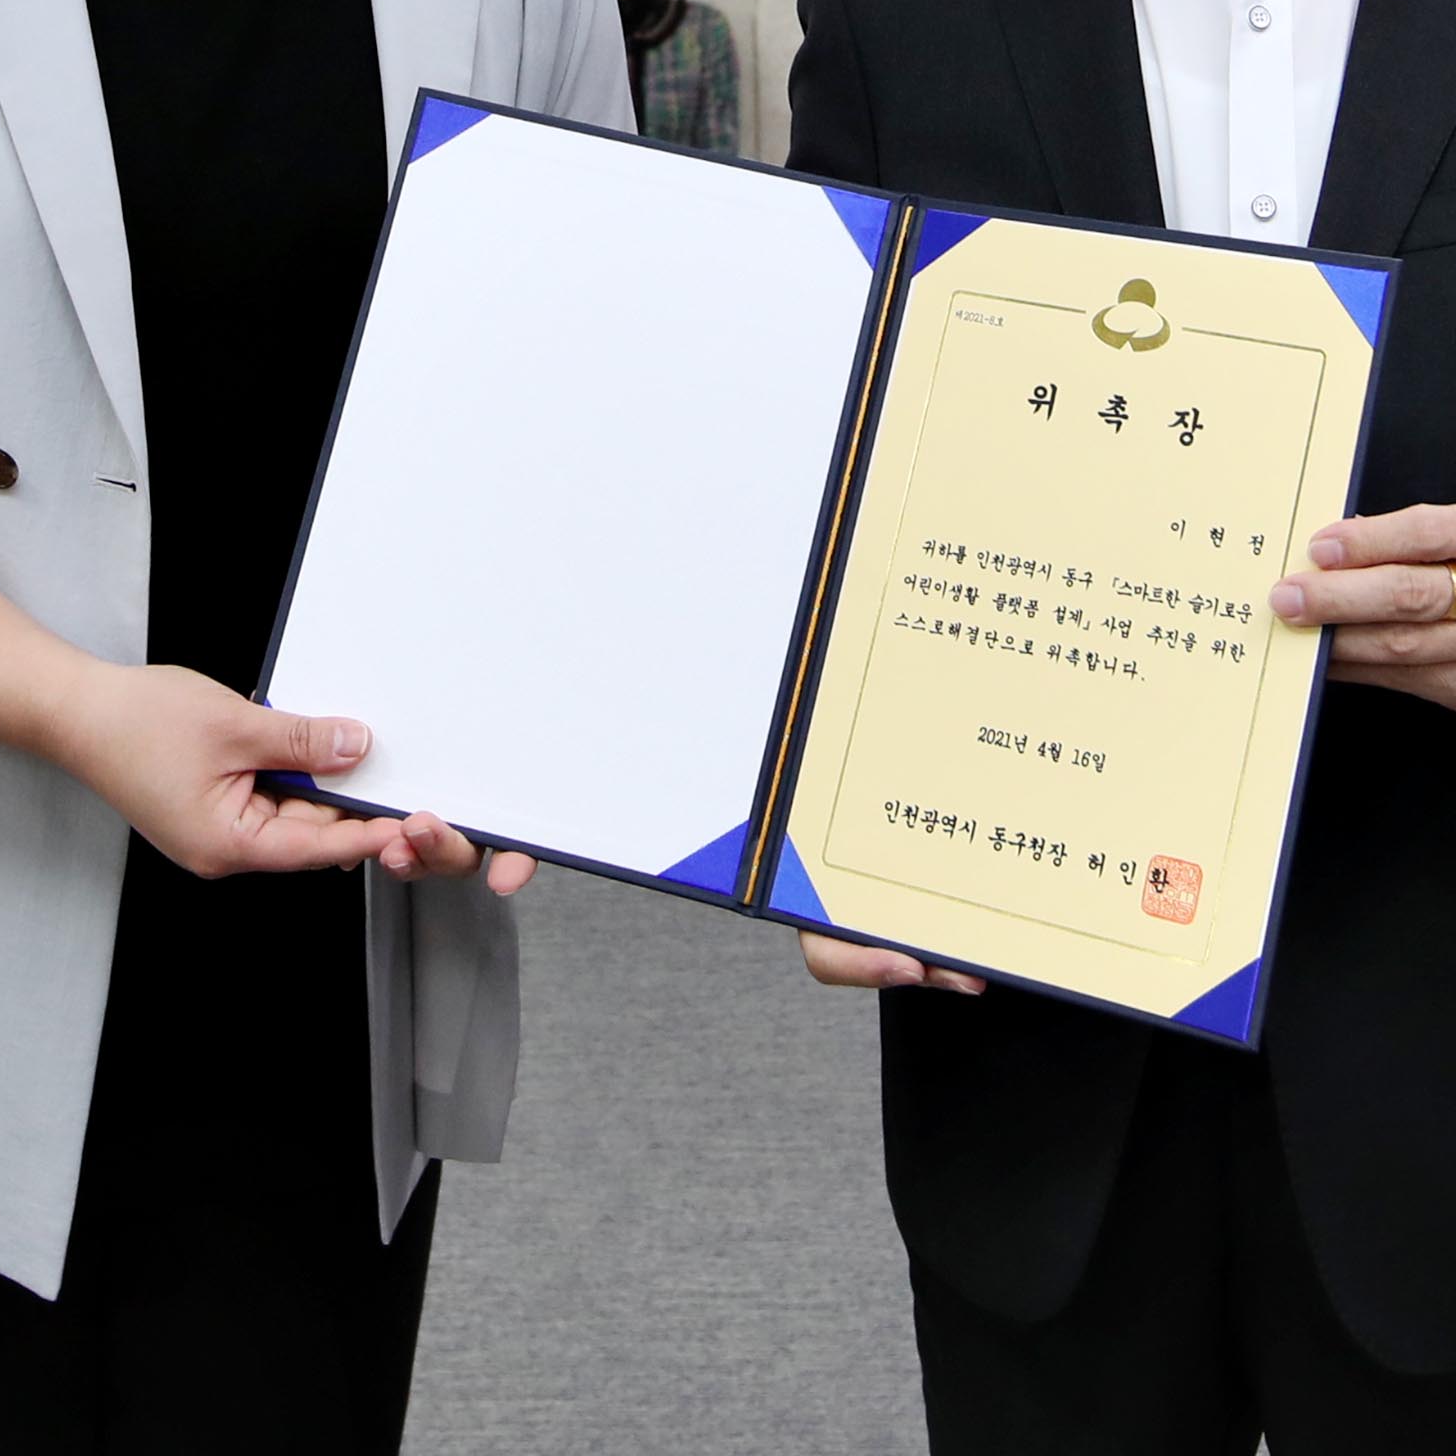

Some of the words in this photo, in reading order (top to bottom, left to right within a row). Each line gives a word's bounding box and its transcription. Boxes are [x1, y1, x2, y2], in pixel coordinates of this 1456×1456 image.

[1027, 383, 1058, 422] 위
[1097, 394, 1130, 435] 촉
[1167, 407, 1204, 447] 장
[922, 540, 967, 565] 귀하를
[977, 551, 1052, 583] 인천광역시
[1062, 567, 1094, 591] 동구
[1188, 594, 1254, 625] 슬기로운
[894, 612, 1035, 656] 스스로해결단으로
[1046, 643, 1146, 682] 위촉합니다.
[903, 574, 980, 606] 어린이생활
[992, 592, 1040, 620] 플랫폼
[1102, 615, 1133, 640] 사업
[1146, 625, 1198, 654] 추진을
[1211, 639, 1246, 664] 위한
[977, 726, 1028, 755] 2021년
[1037, 741, 1063, 763] 4월
[1071, 748, 1106, 774] 16일
[884, 799, 977, 844] 인천광역시
[988, 827, 1068, 867] 동구청장
